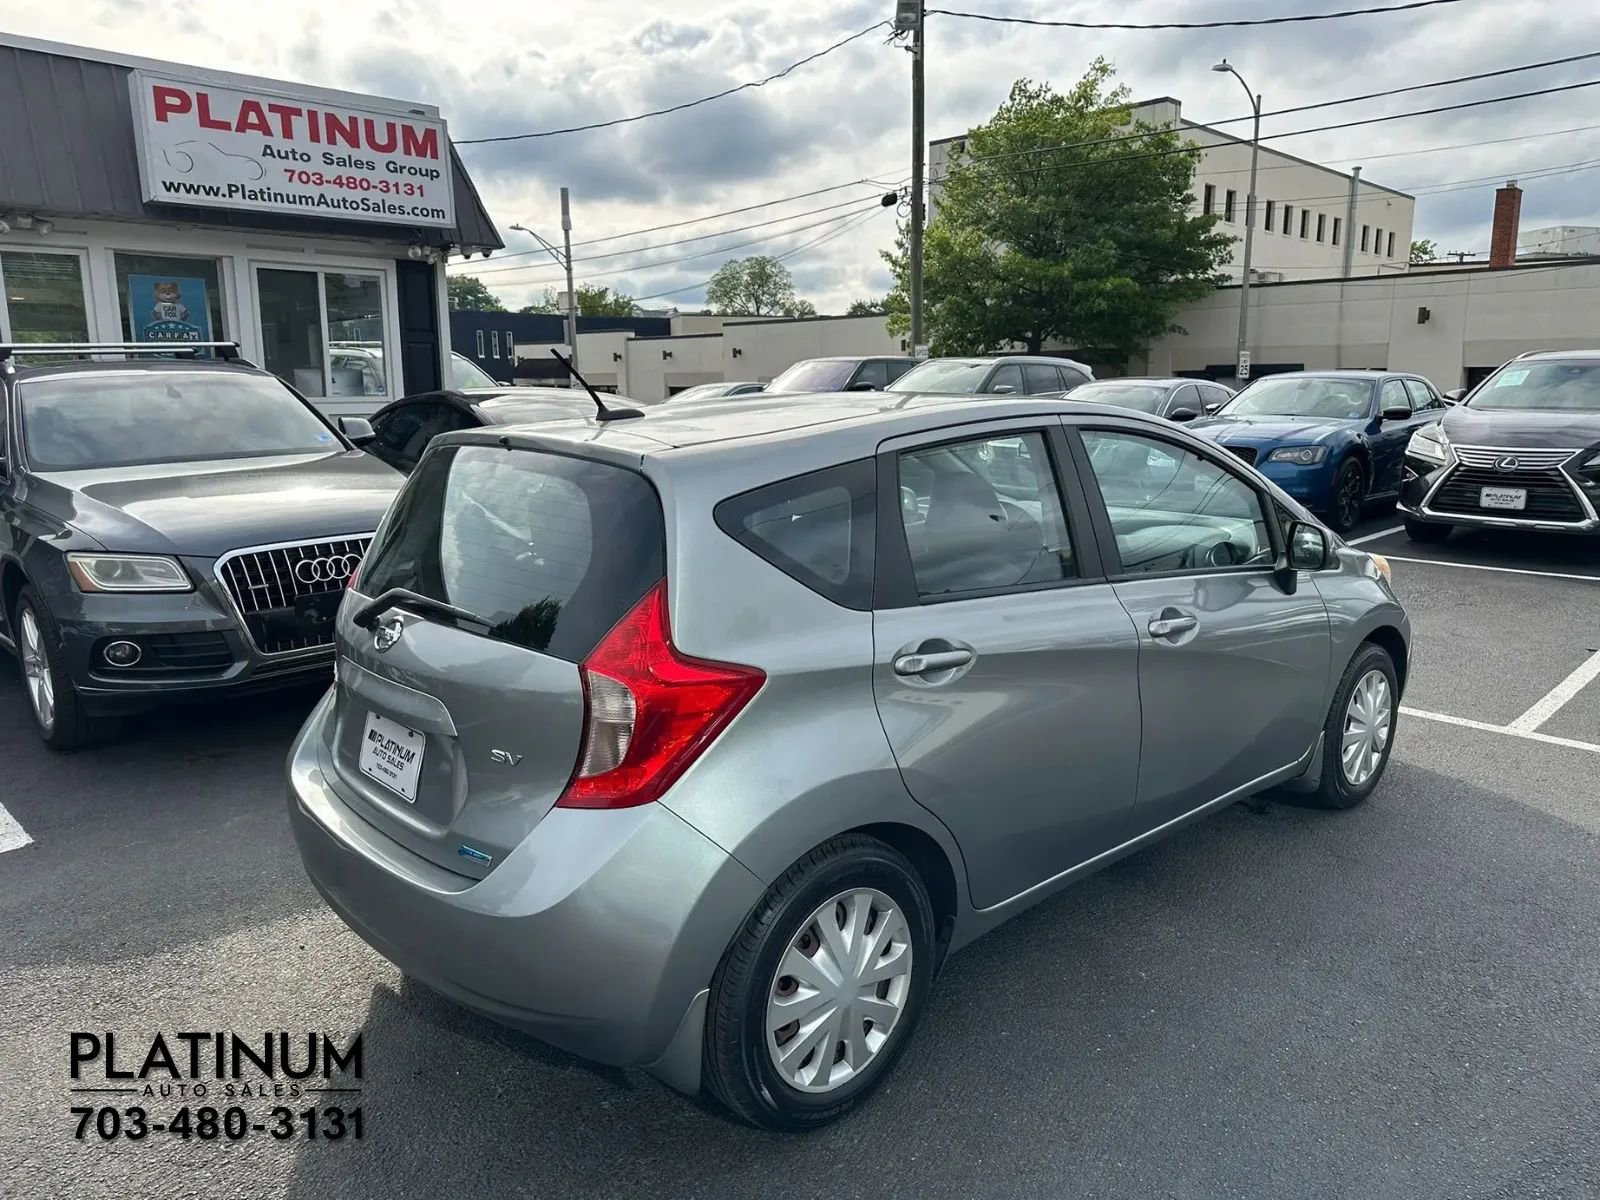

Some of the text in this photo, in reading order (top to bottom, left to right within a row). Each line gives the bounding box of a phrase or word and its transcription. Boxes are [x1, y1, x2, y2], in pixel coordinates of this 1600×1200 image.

[152, 85, 439, 160] PLATINUM
[261, 144, 441, 181] Auto Sales Group
[283, 168, 425, 197] 703-480-3131
[161, 180, 446, 219] www.PlatinumAutoSales.com
[148, 331, 199, 340] CARFAX
[1240, 365, 1248, 375] 25
[372, 746, 405, 771] AUTO SALES
[375, 733, 416, 764] PLATINUM
[490, 749, 523, 766] SV
